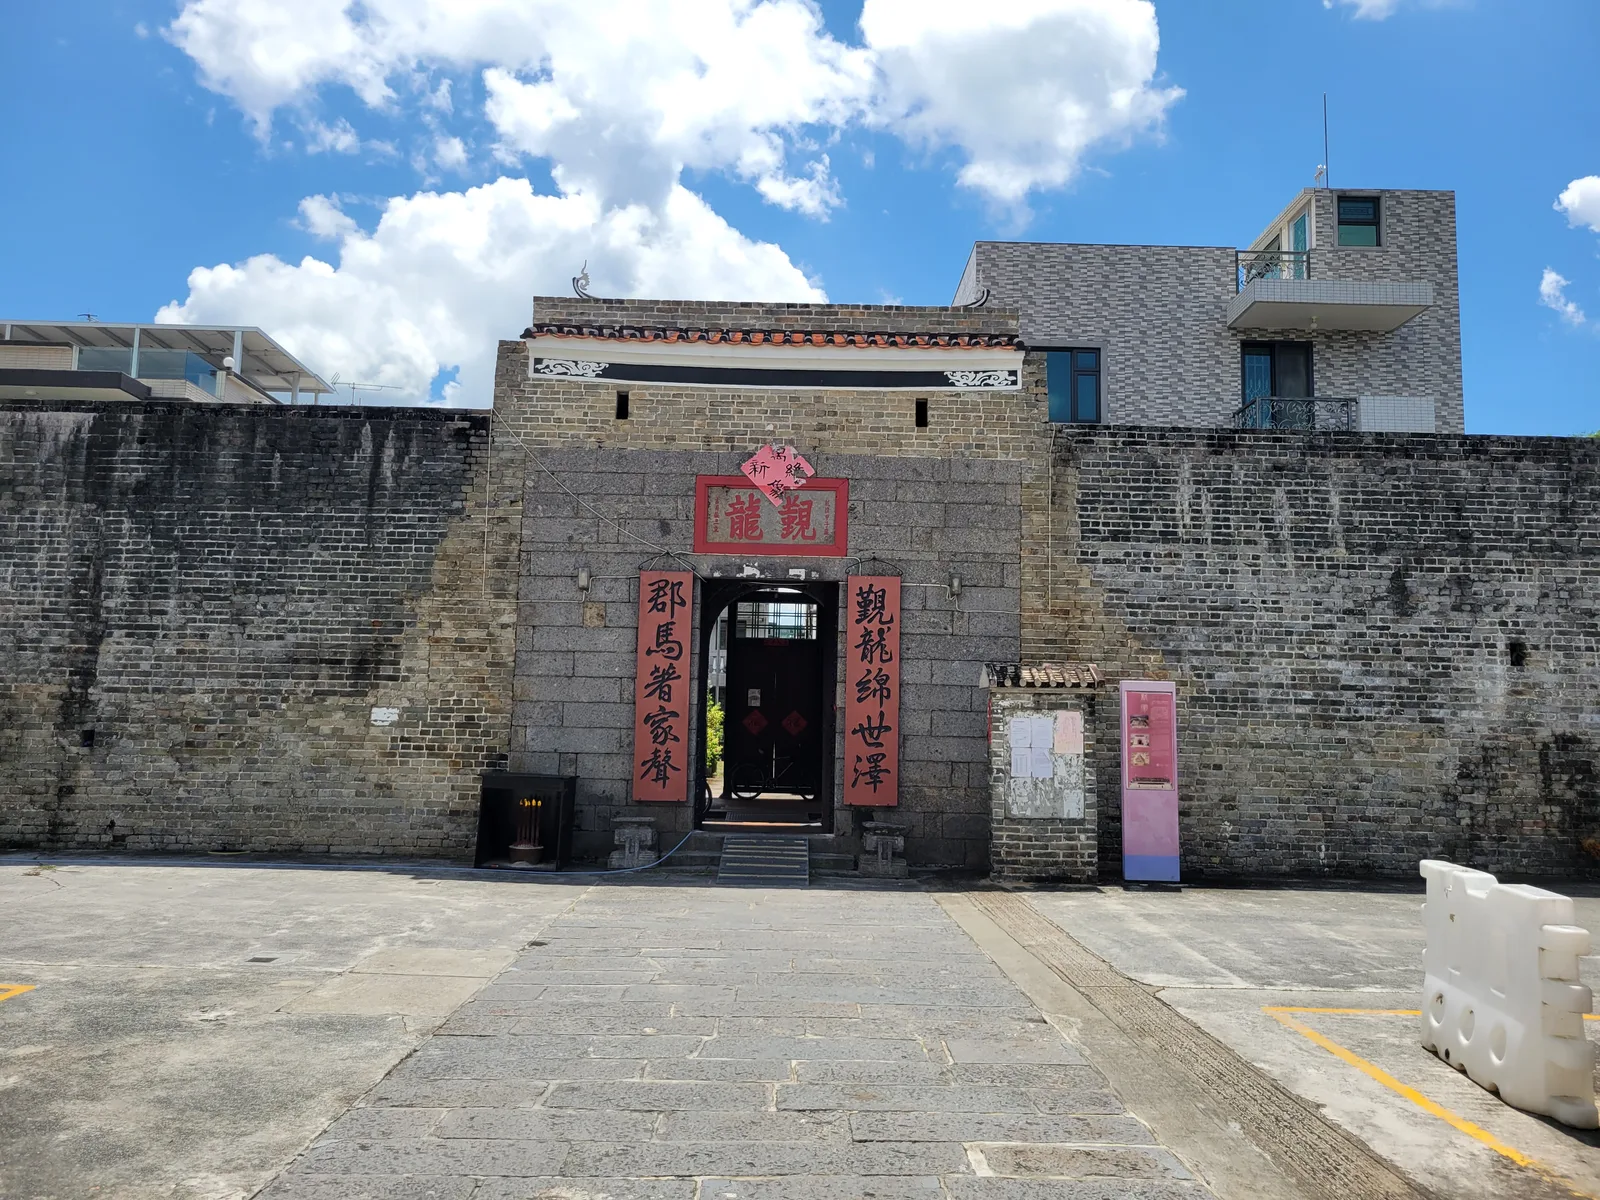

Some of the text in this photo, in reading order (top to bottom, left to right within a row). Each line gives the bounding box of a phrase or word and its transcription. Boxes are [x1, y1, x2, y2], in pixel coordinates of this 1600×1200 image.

[850, 583, 894, 794] 覲龍綿世澤
